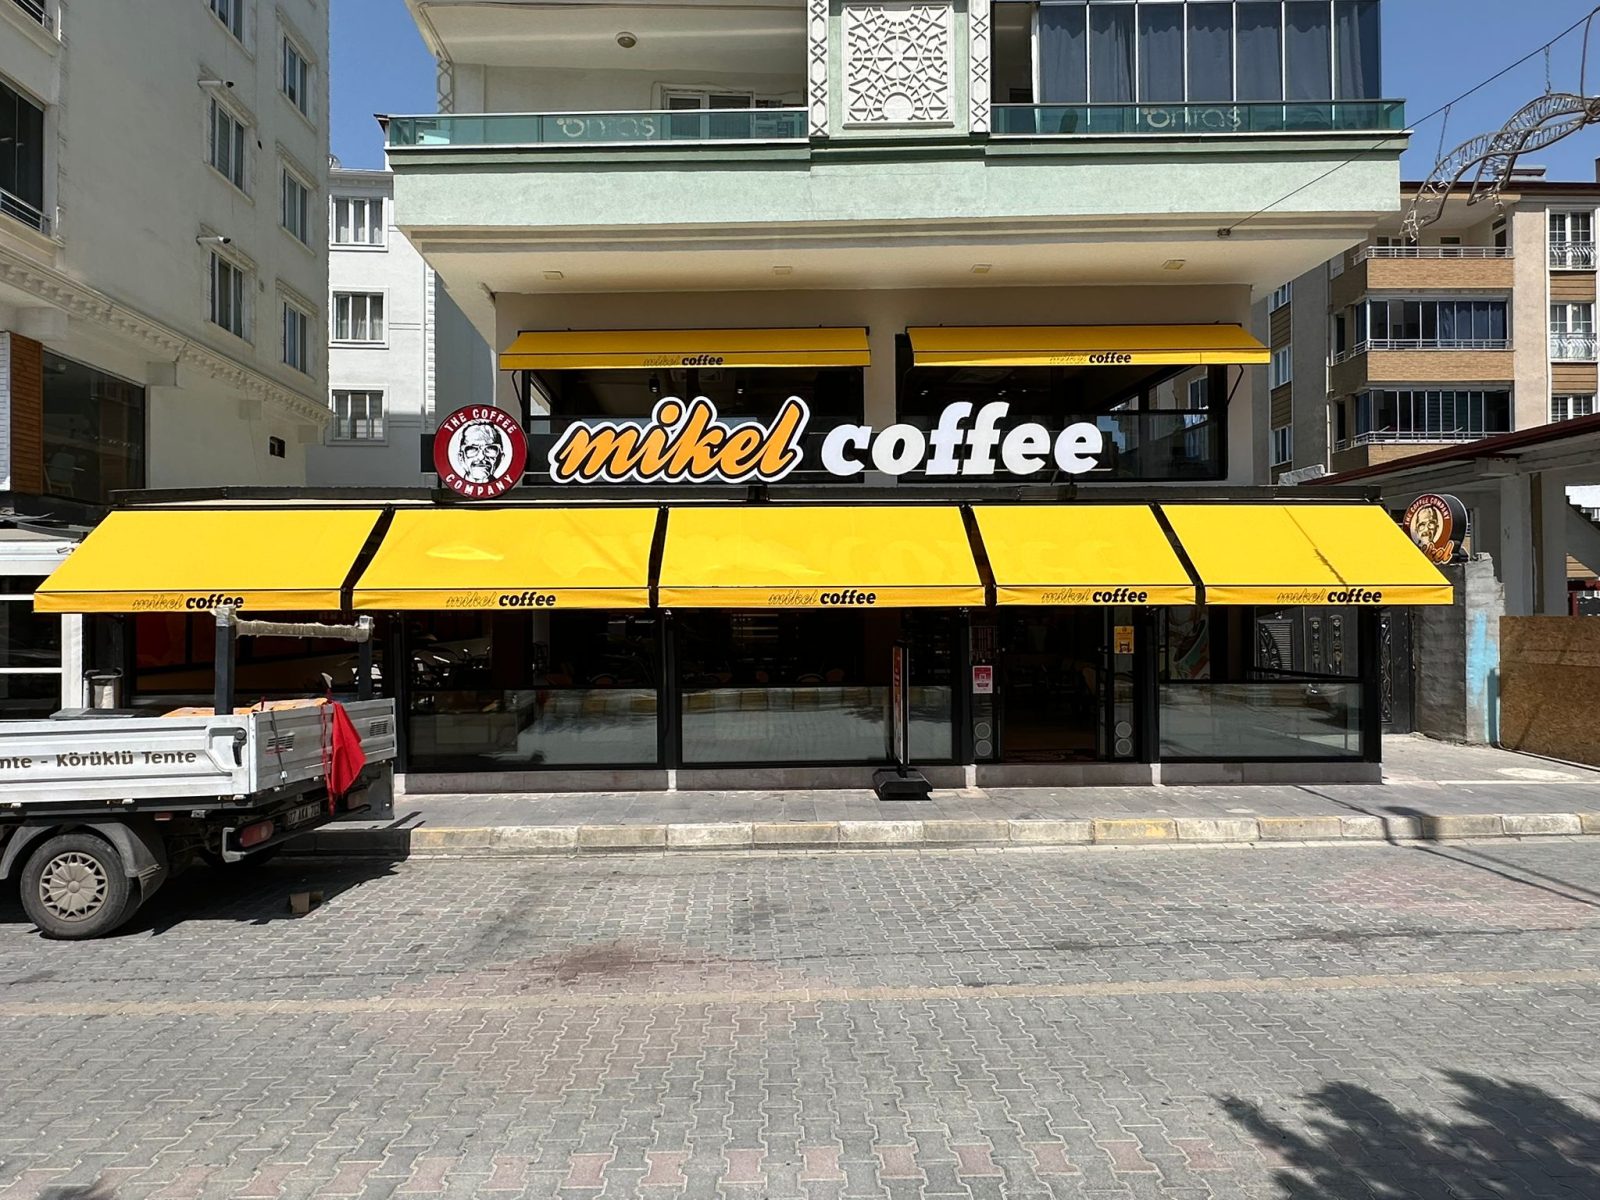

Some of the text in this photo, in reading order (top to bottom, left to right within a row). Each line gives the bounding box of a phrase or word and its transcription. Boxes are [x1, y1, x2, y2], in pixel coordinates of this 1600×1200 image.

[681, 354, 723, 365] coffee
[1089, 352, 1131, 363] coffee
[444, 408, 517, 434] THE COFFEE
[551, 398, 1103, 481] mikel coffee
[445, 474, 513, 496] COMPANY
[186, 593, 244, 609] coffee
[498, 591, 556, 607] coffee
[820, 589, 876, 605] coffee
[1092, 588, 1147, 603] coffee
[1327, 588, 1382, 603] coffee
[56, 751, 134, 767] Körüklü
[141, 751, 197, 764] Tente
